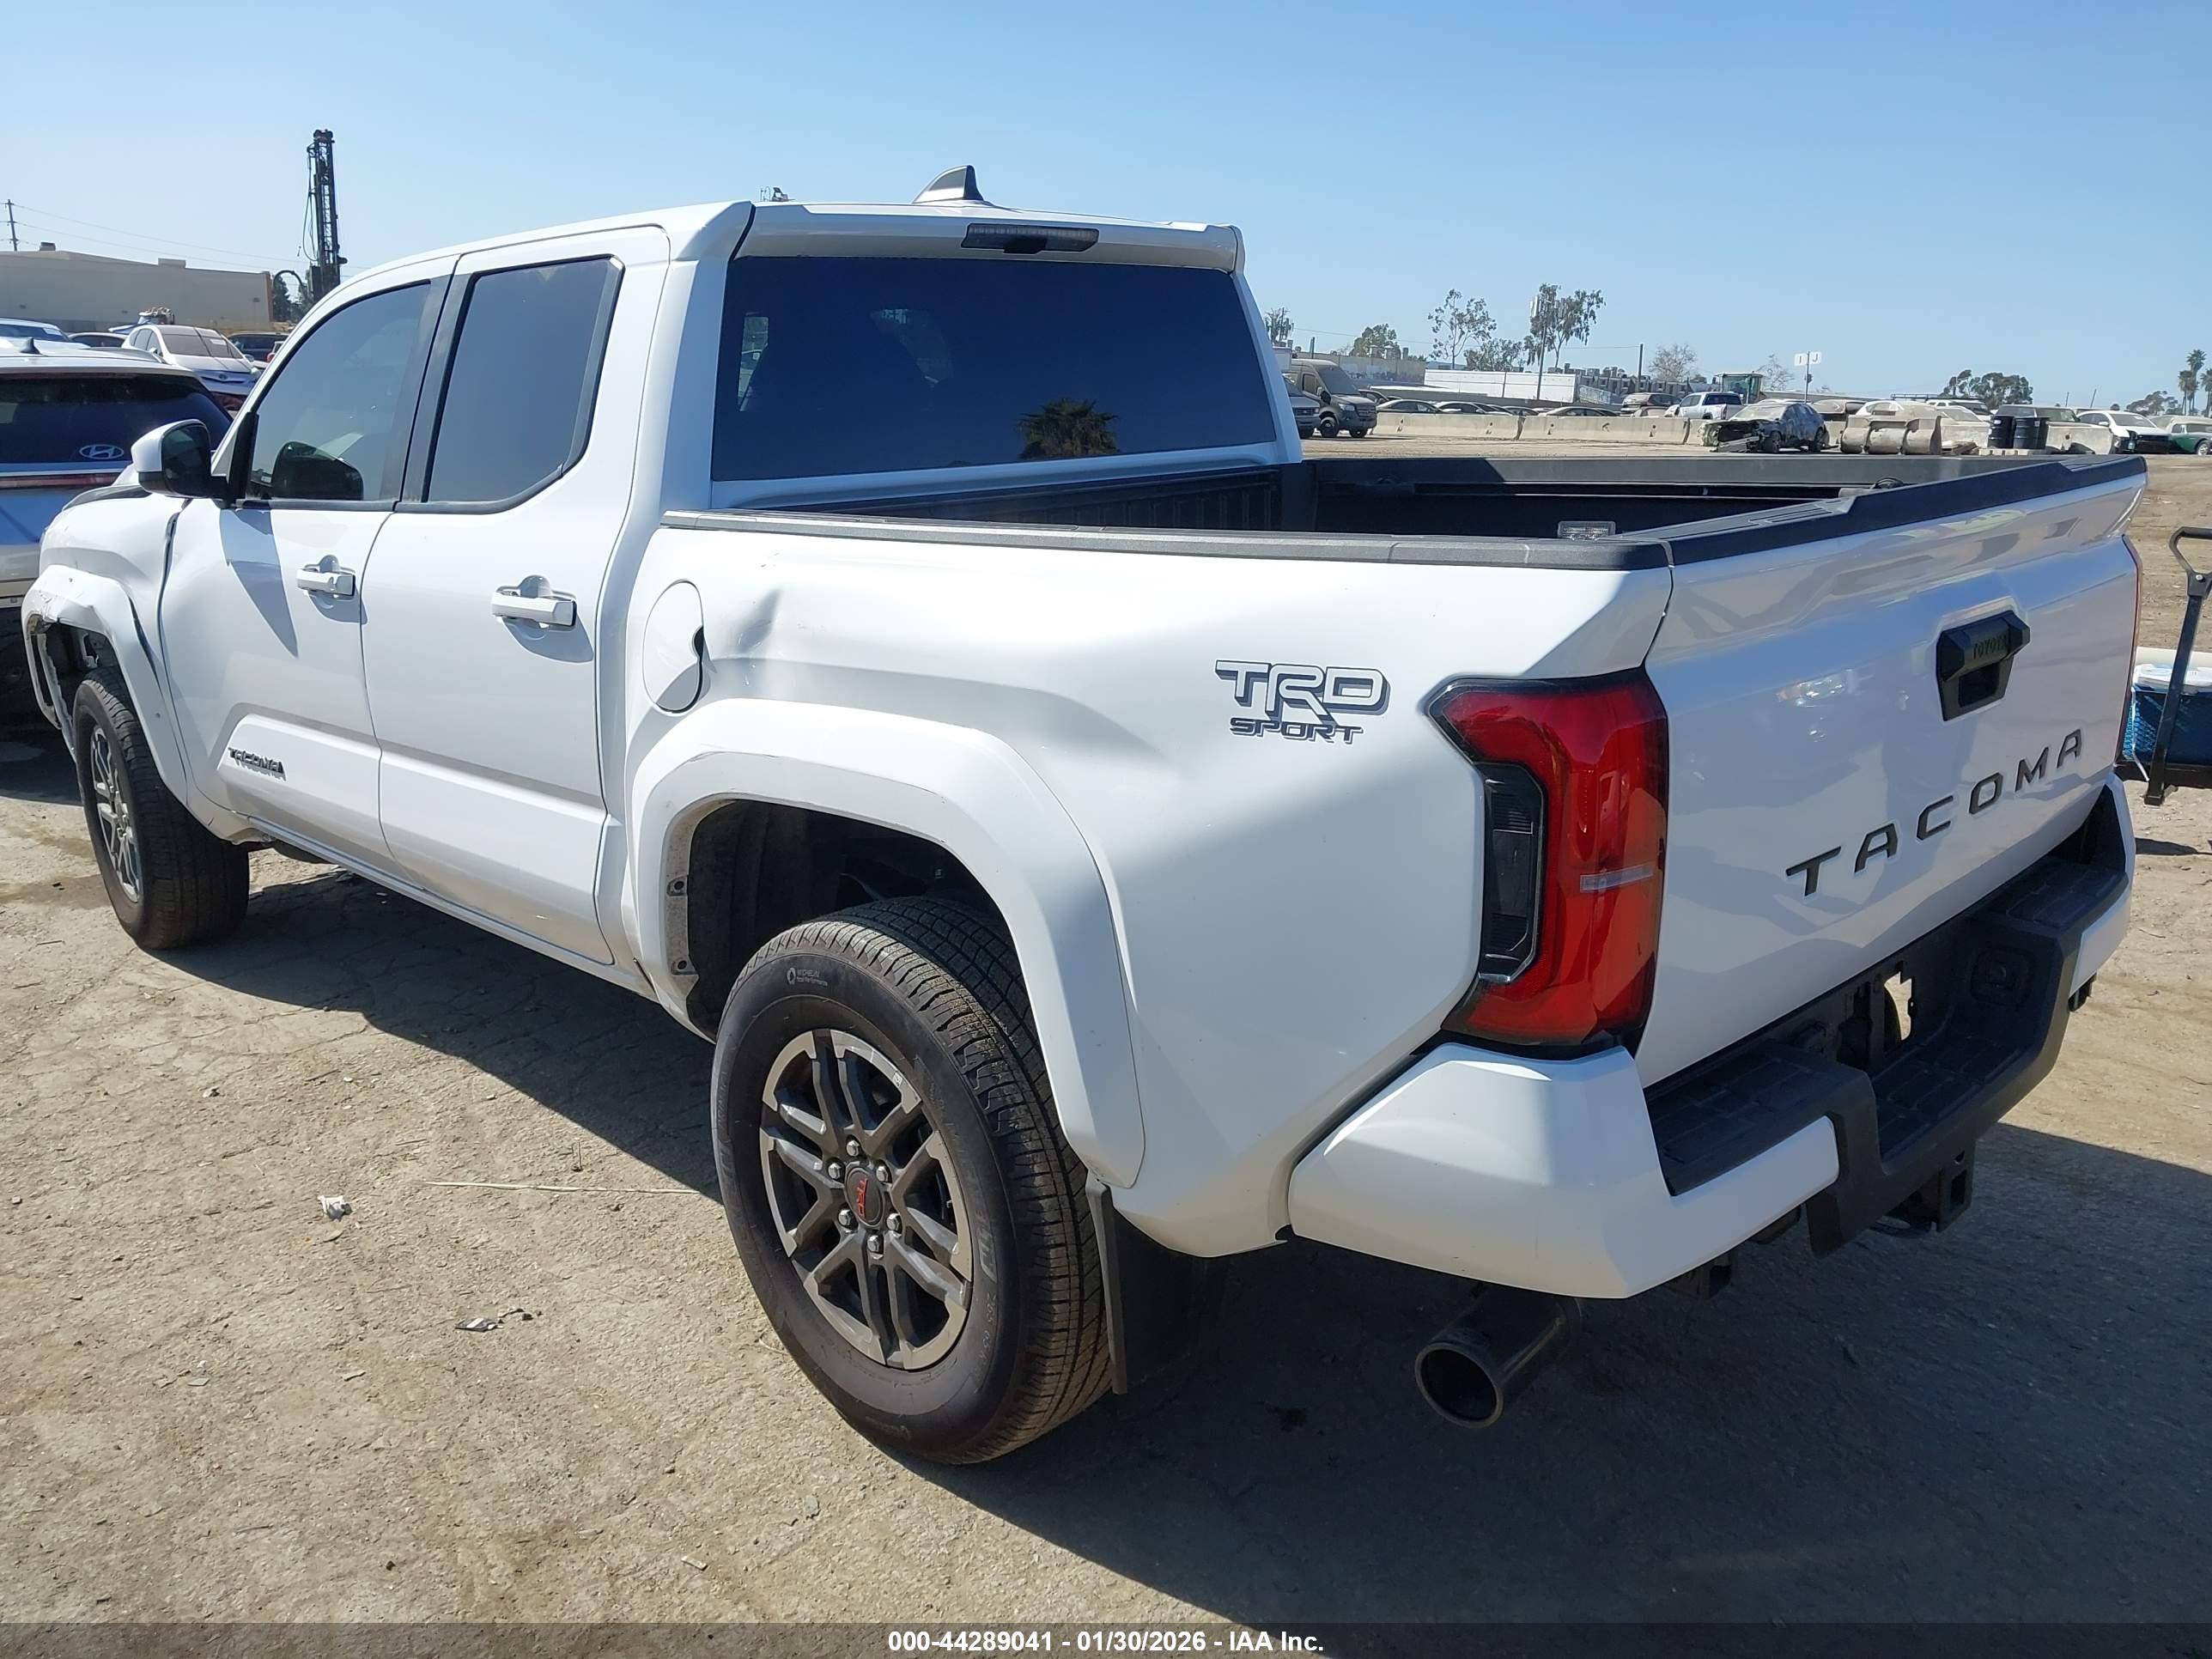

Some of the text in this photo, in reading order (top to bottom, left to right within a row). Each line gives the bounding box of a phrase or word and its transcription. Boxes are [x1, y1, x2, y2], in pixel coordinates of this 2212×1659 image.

[1214, 659, 1392, 726] TRD
[1229, 716, 1364, 745] SPORT
[227, 746, 286, 778] TACOMA
[1785, 728, 2082, 896] TACOMA
[855, 1177, 868, 1219] TRD
